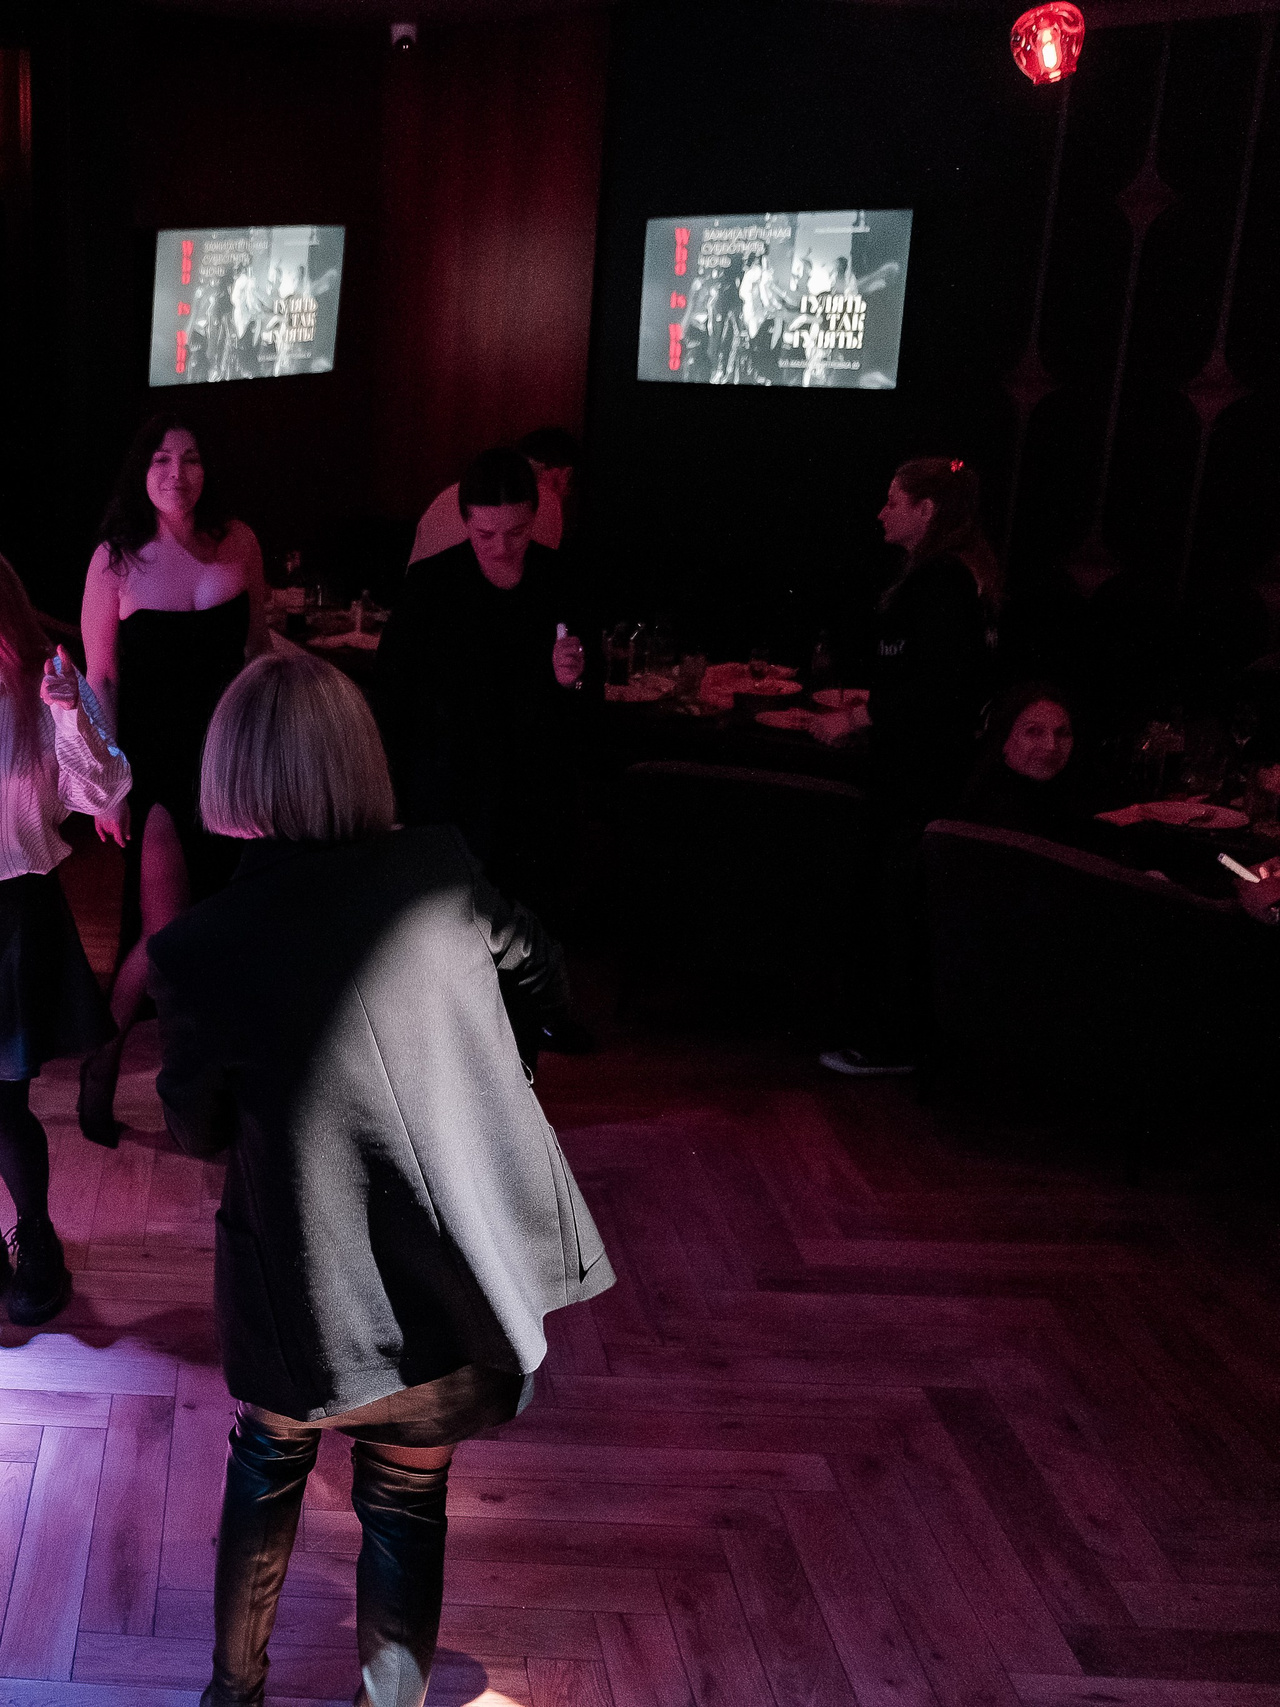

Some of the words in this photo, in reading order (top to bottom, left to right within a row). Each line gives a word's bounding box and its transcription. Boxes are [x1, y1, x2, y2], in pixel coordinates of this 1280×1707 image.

[800, 294, 866, 313] ГУЛЯТЬ
[825, 313, 865, 331] ТАК
[879, 640, 907, 656] ho?
